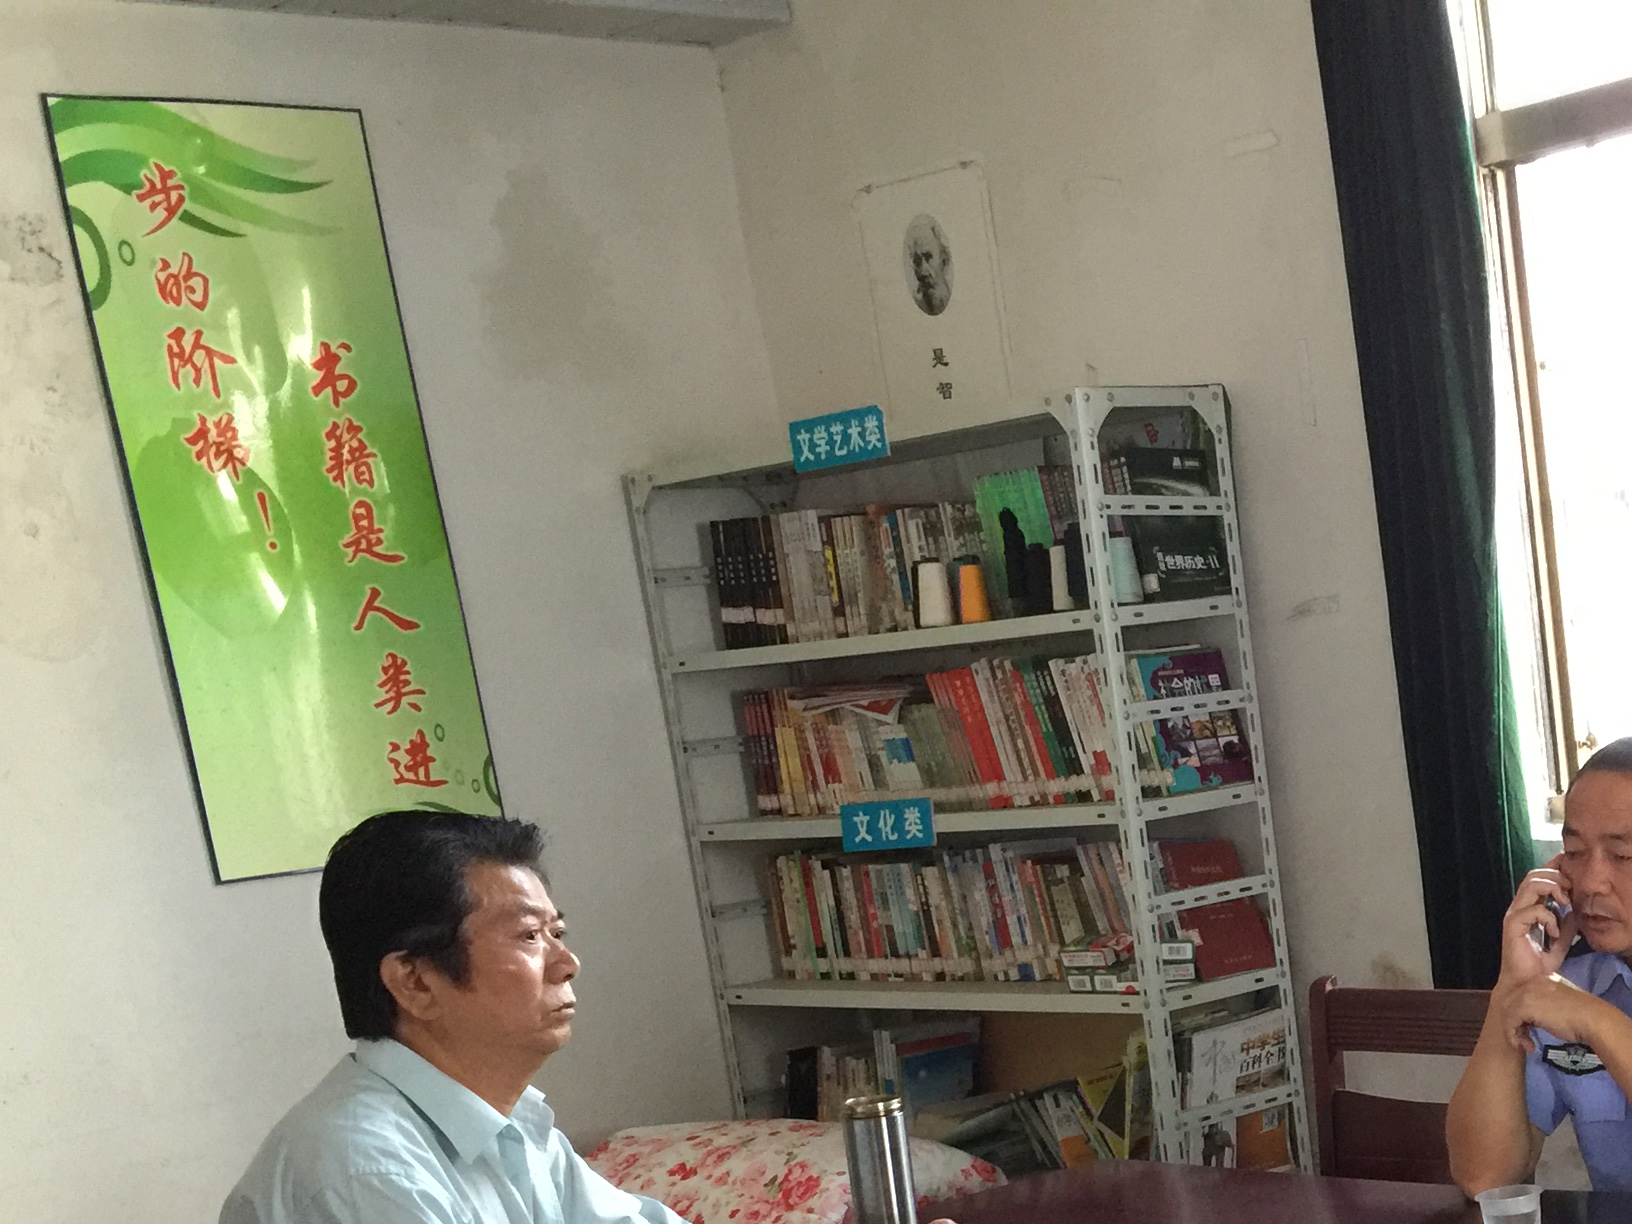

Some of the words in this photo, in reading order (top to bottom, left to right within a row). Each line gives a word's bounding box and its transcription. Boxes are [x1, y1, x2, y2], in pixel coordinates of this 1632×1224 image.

[135, 162, 278, 551] 步的阶梯！
[797, 414, 882, 462] 文学艺术类
[311, 341, 448, 788] 书籍是人类进
[853, 806, 924, 843] 文化类
